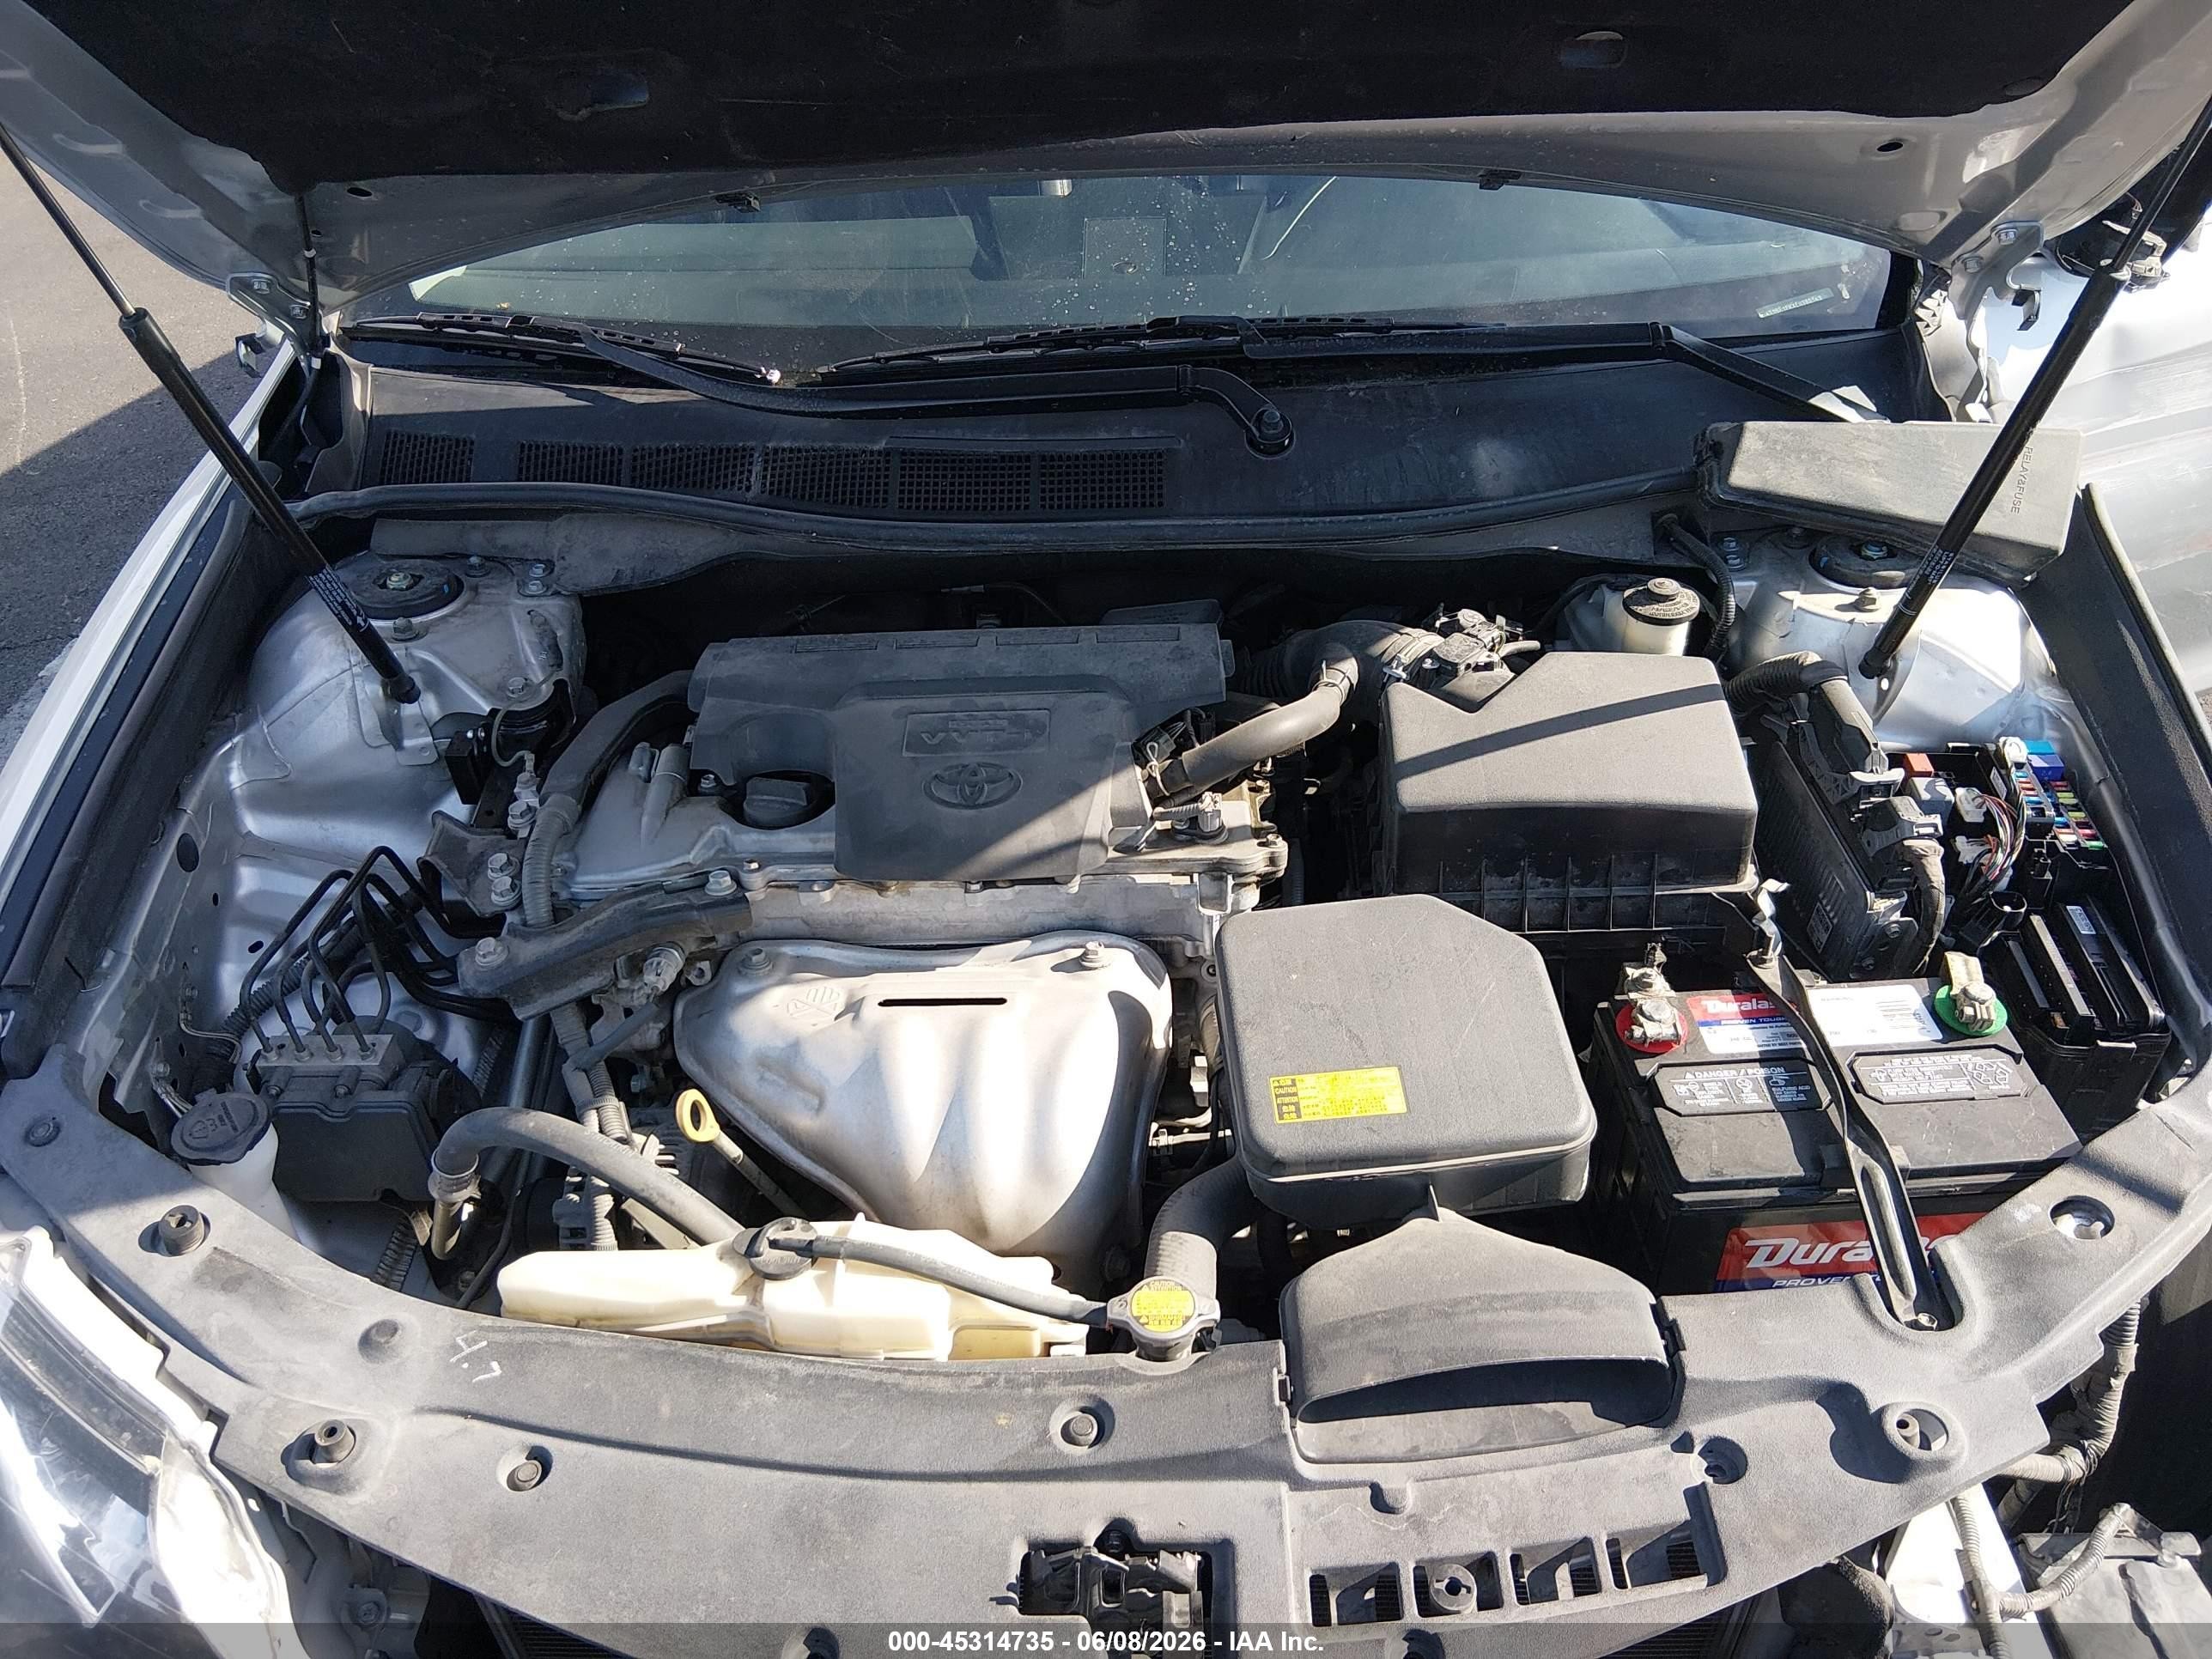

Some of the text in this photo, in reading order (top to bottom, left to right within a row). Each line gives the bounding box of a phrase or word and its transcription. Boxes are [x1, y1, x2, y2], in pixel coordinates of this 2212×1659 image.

[2010, 446, 2033, 514] RELAY&FUSE
[1694, 1069, 1738, 1079] DANGER
[1746, 1066, 1786, 1076] POISON
[1274, 1086, 1297, 1095] CAUTION
[1745, 1237, 1874, 1268] Dura
